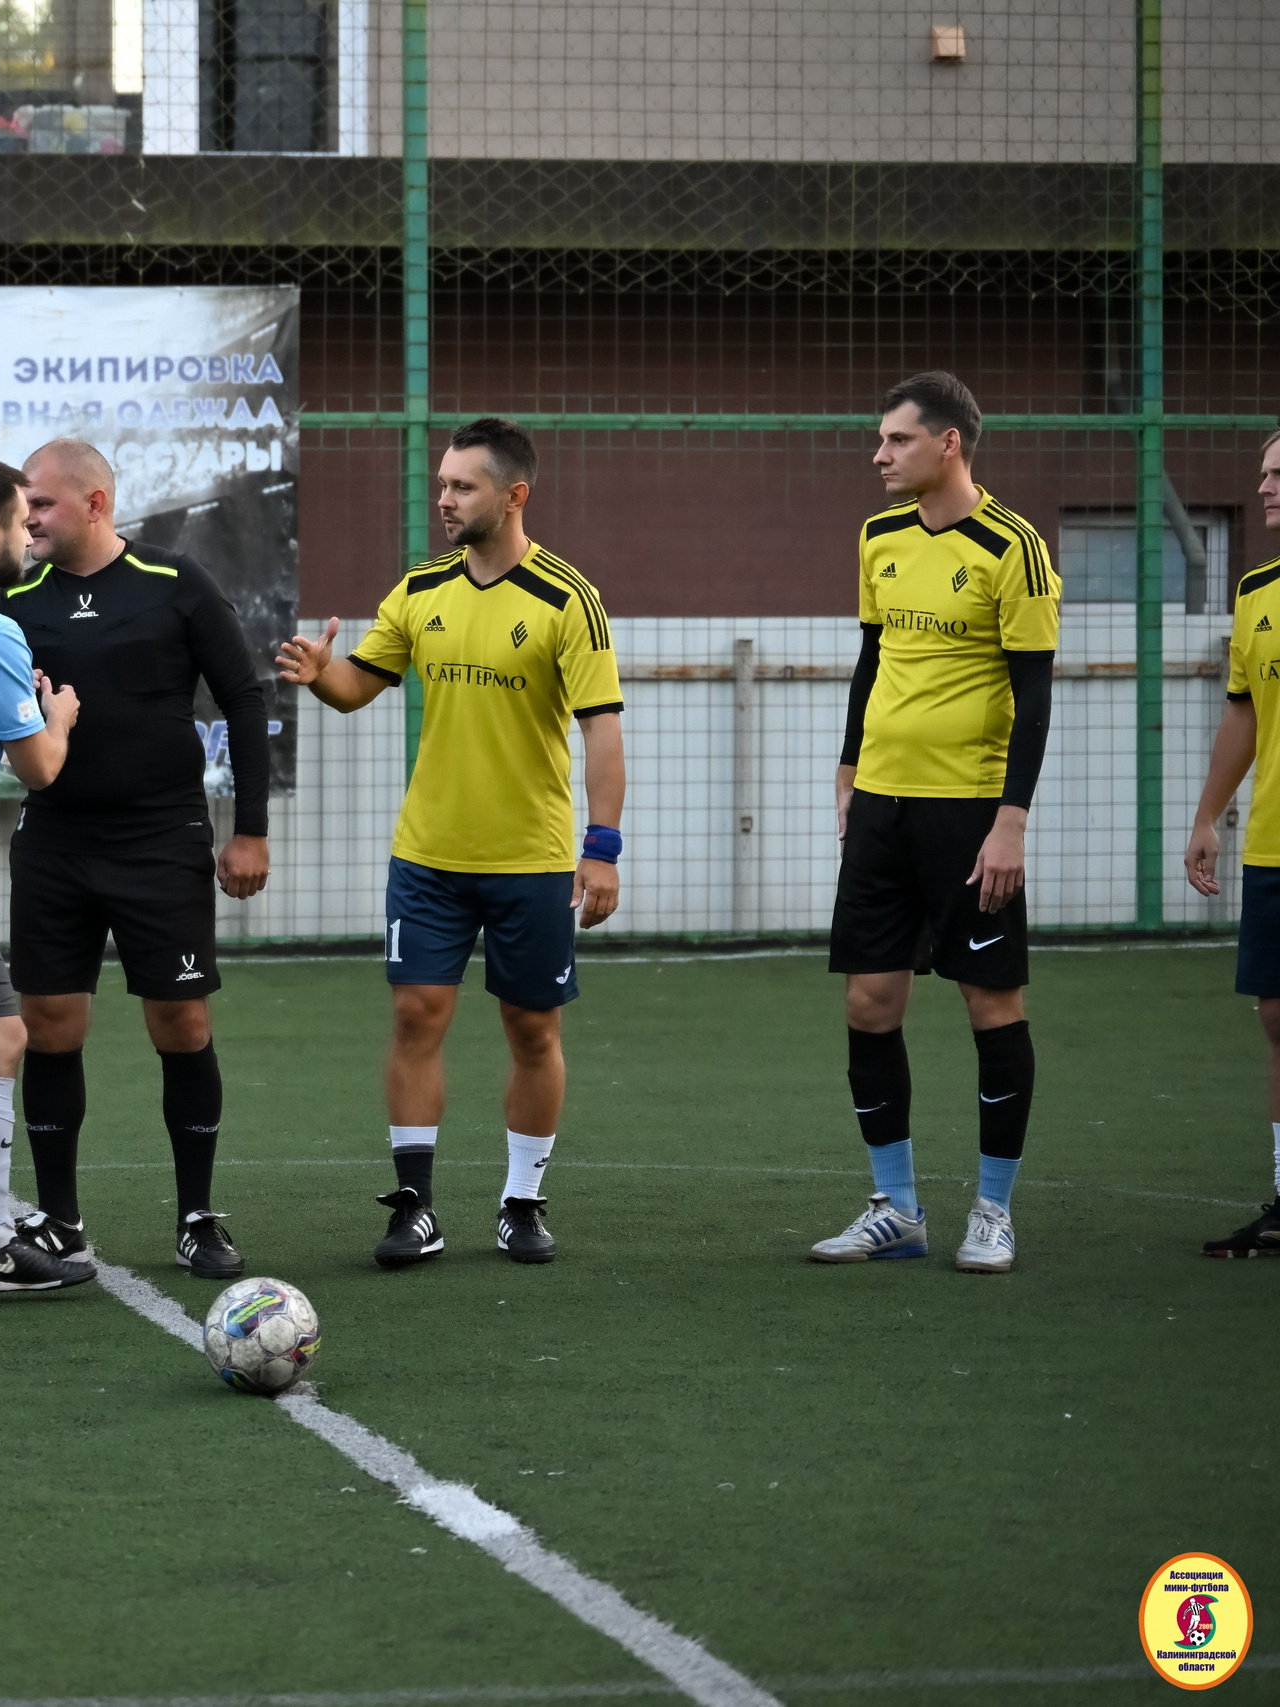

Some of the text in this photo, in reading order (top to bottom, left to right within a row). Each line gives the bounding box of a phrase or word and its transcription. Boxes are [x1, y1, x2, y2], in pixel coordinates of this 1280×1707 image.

[14, 353, 284, 384] ЭКИПИРОВКА
[117, 397, 284, 430] ОДЕЖДА
[26, 1123, 64, 1131] ÖGEL
